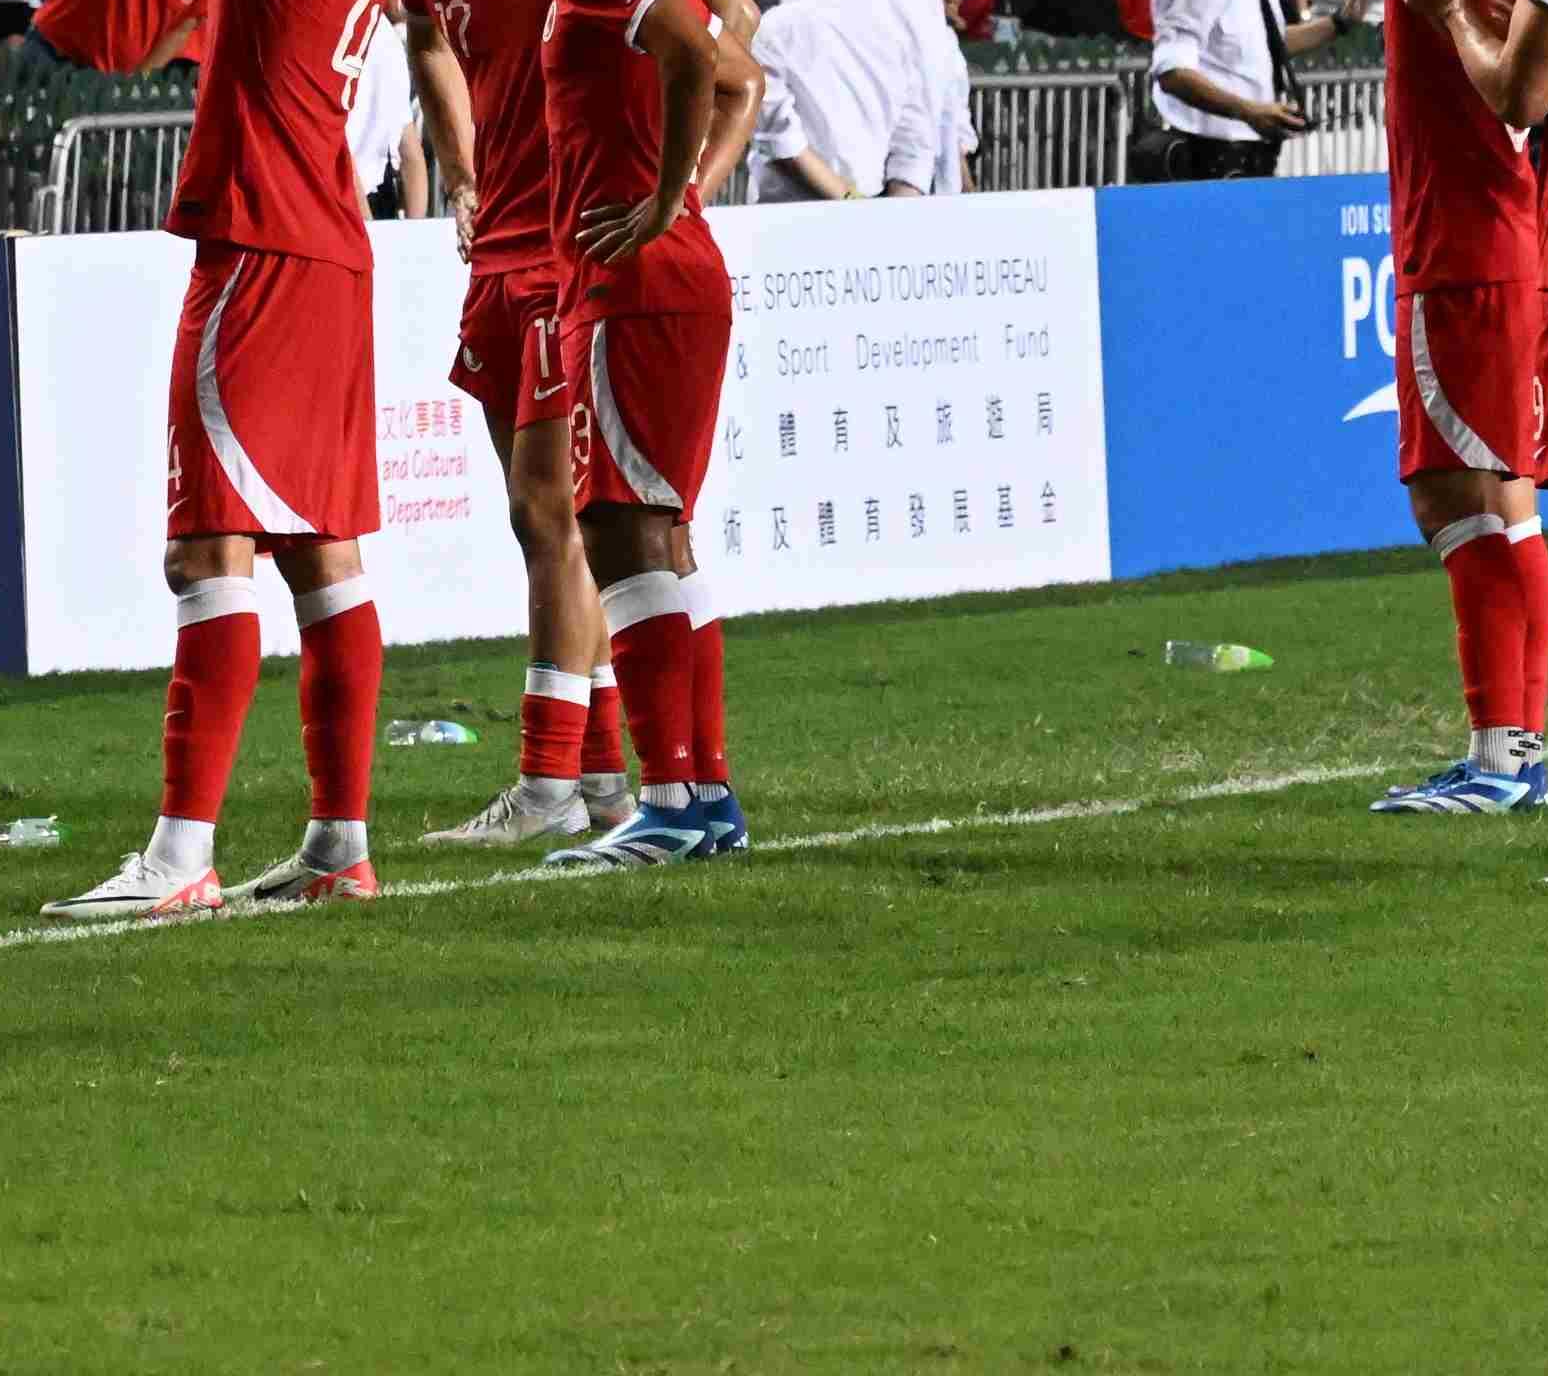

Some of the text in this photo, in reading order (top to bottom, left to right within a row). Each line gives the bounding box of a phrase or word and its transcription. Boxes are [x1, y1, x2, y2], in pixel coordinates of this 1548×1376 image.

[763, 268, 837, 311] SPORTS
[842, 265, 882, 305] AND
[885, 259, 970, 303] TOURISM
[974, 255, 1049, 297] BUREAU
[735, 321, 1050, 384] & Sport Development Fund
[382, 446, 470, 482] and Cultural
[386, 495, 473, 525] Department
